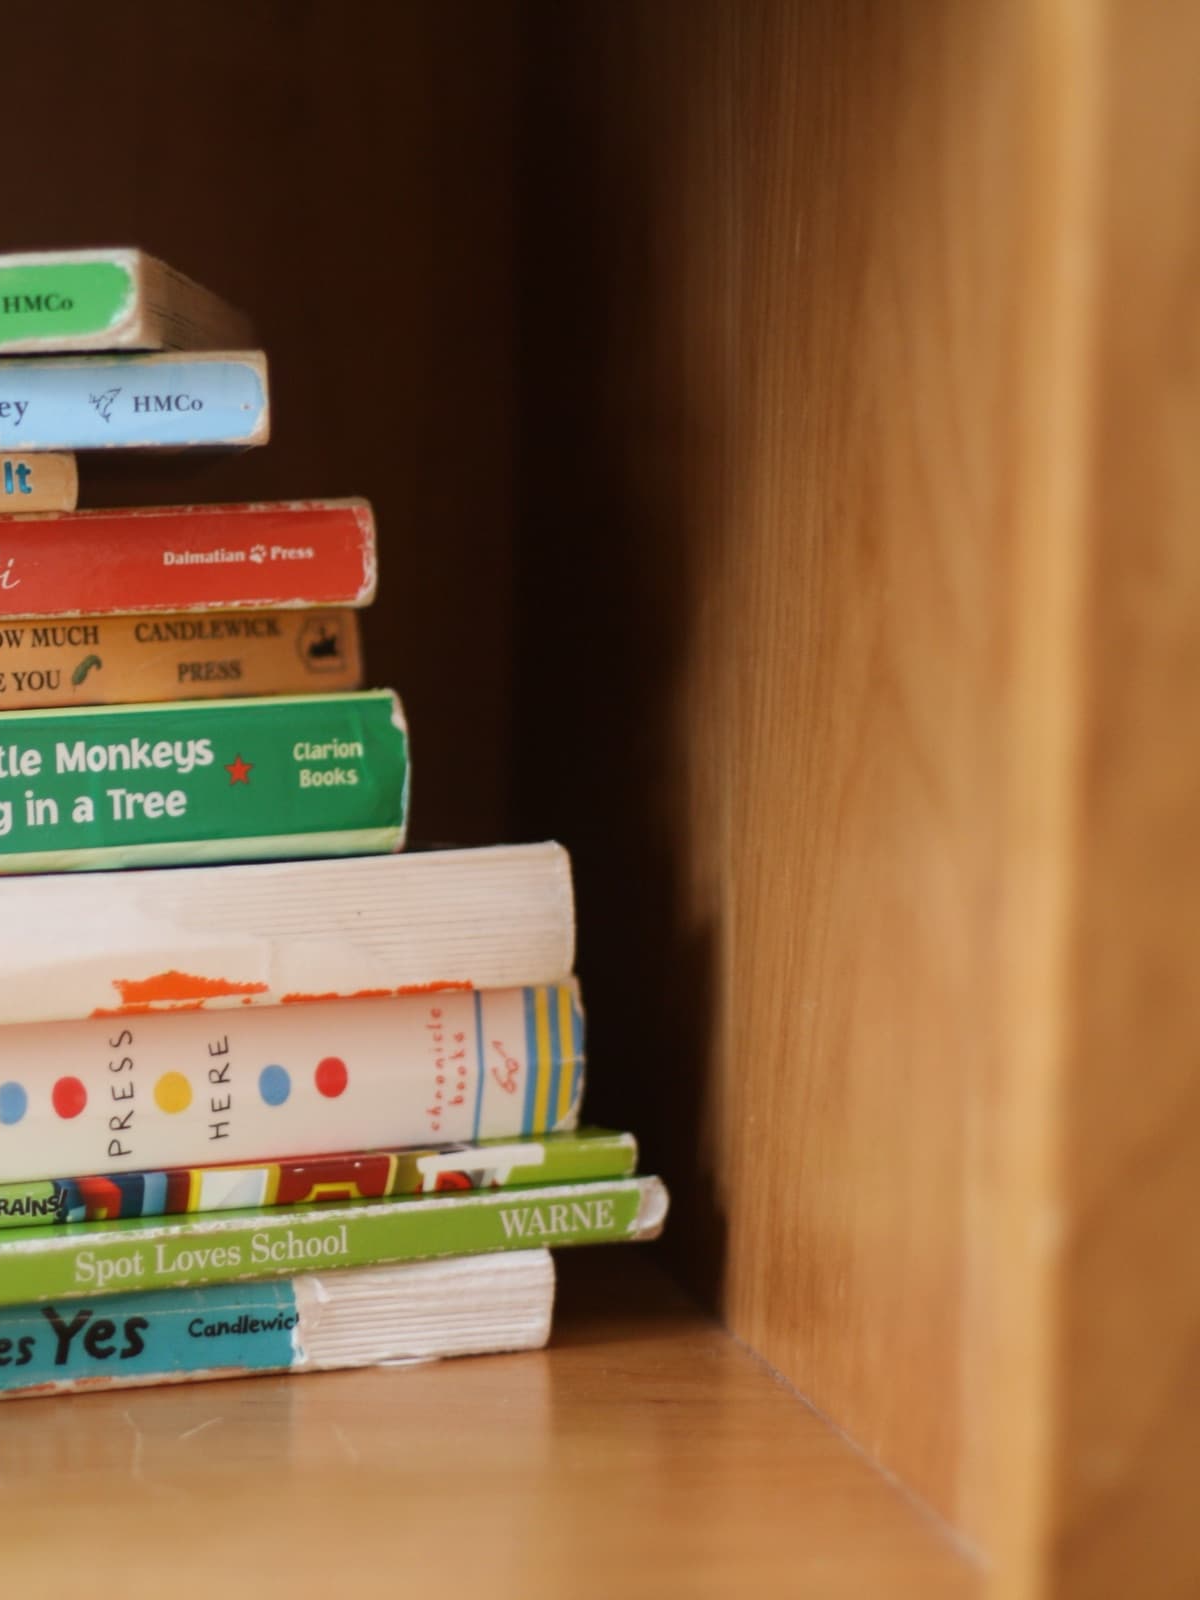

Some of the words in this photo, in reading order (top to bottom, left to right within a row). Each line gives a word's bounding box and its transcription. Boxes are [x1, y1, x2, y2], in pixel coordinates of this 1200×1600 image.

[1, 294, 74, 315] HMCo
[132, 394, 204, 414] HMCo
[3, 460, 33, 495] It
[162, 547, 247, 567] Dalmatian
[270, 544, 315, 562] Press
[30, 625, 100, 649] MUCH
[133, 616, 283, 644] CANDLEWICK
[11, 669, 61, 692] YOU
[177, 660, 243, 684] PRESS
[55, 737, 215, 775] Monkeys
[293, 738, 364, 762] Clarion
[299, 767, 359, 789] Books
[24, 789, 59, 827] in
[71, 795, 94, 824] a
[105, 788, 188, 822] Tree
[425, 1007, 446, 1132] chronicle
[448, 1031, 467, 1106] books
[107, 1028, 135, 1158] PRESS
[208, 1034, 232, 1141] HERE
[499, 1199, 616, 1239] WARNE
[74, 1250, 144, 1286] Spot
[155, 1240, 242, 1275] Loves
[251, 1226, 349, 1262] School
[41, 1306, 150, 1366] Yes
